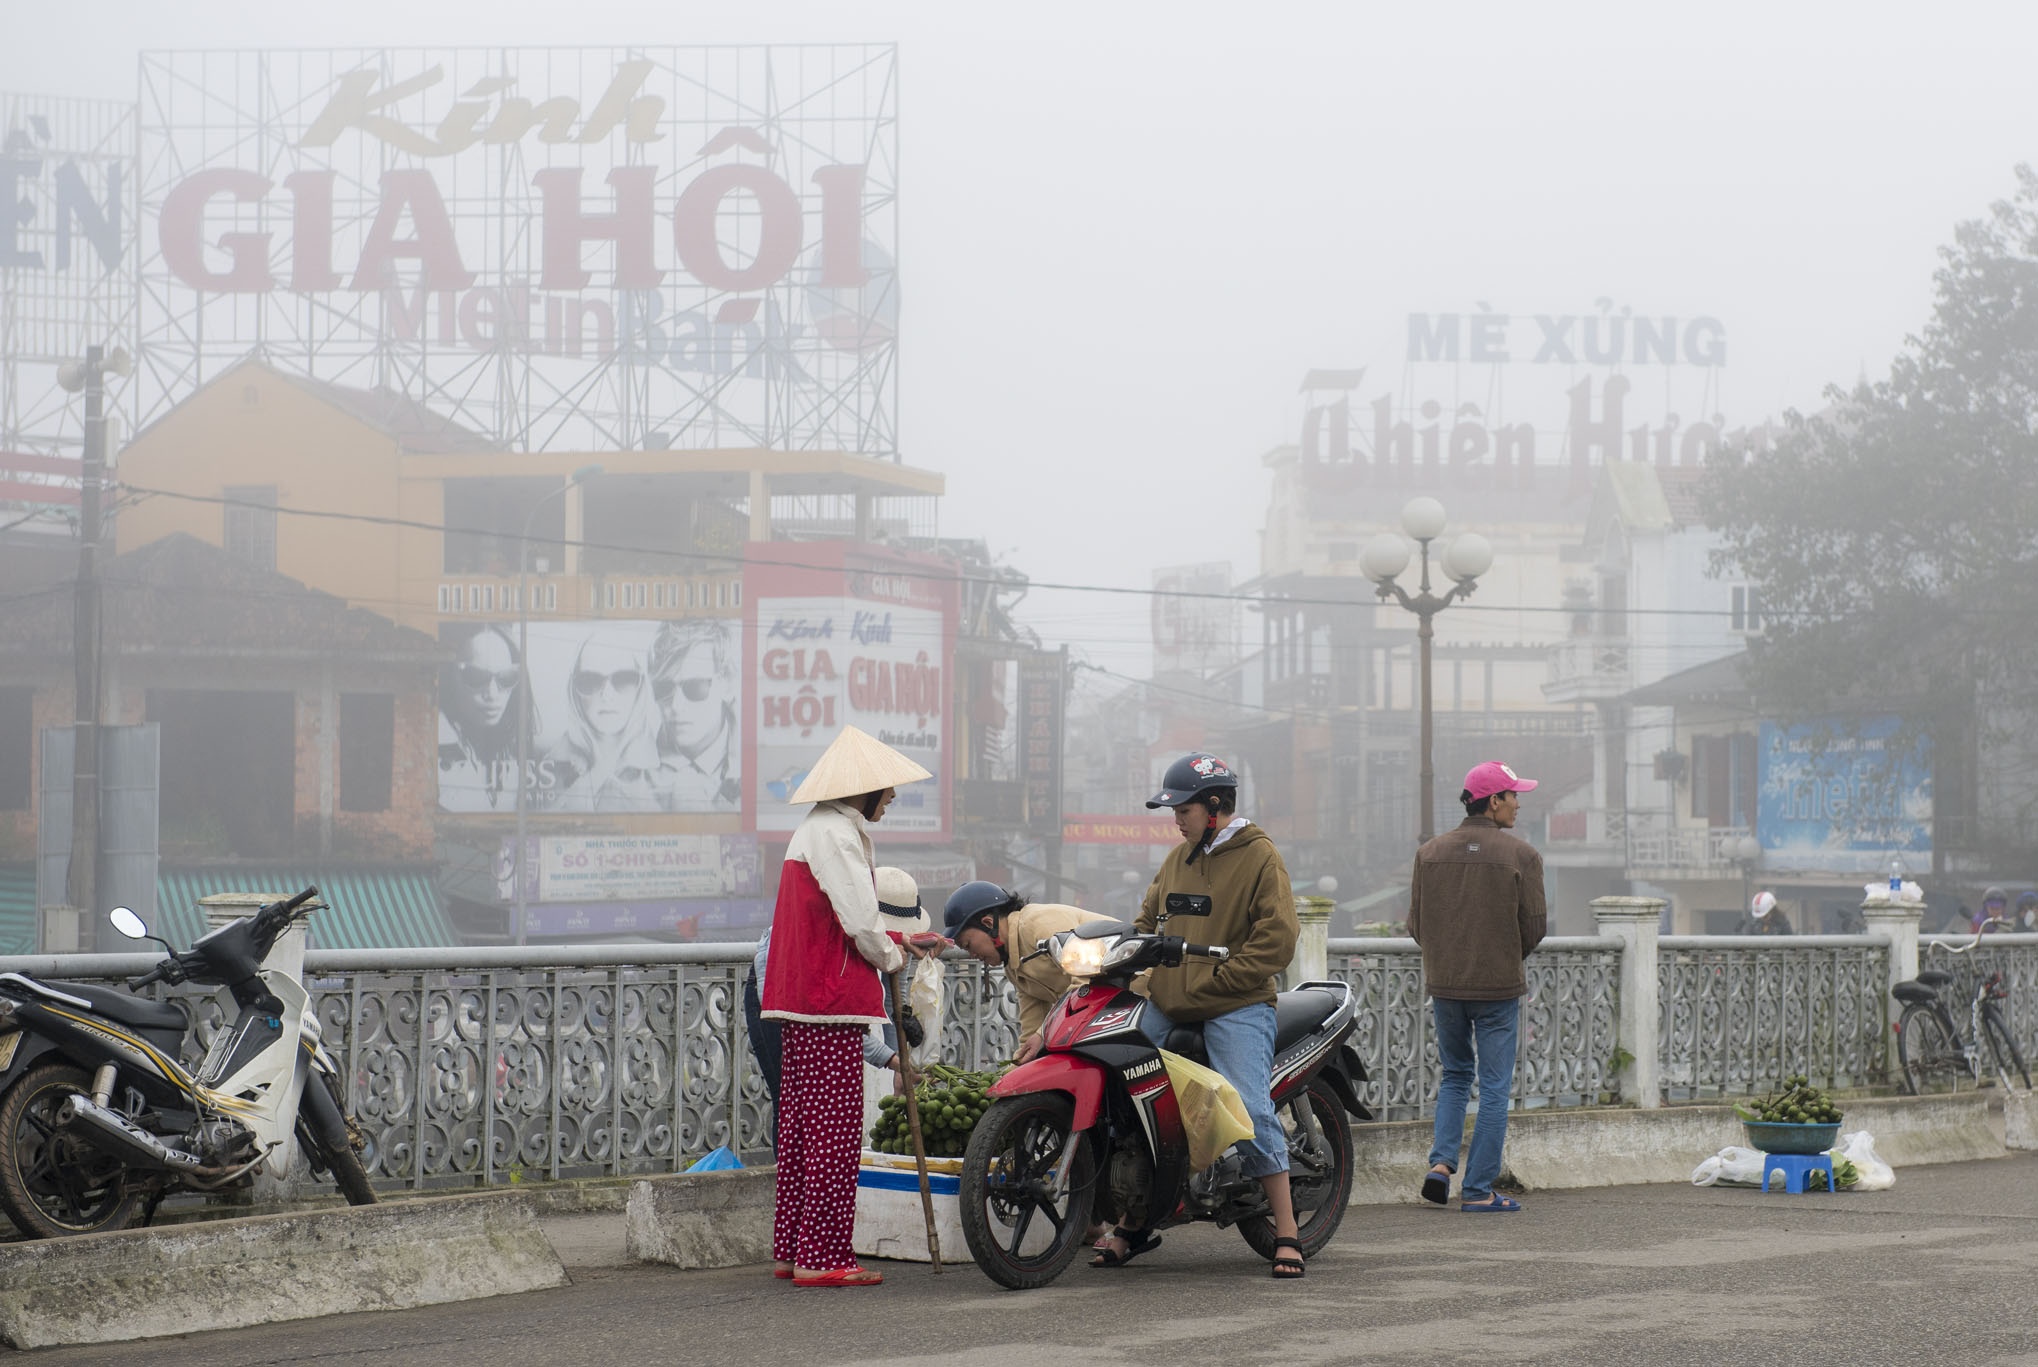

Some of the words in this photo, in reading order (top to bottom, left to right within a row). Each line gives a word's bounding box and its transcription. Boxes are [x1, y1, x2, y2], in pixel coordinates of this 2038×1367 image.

[300, 58, 669, 158] Kính
[158, 167, 478, 293] GIA
[532, 126, 873, 323] HỘI
[1407, 300, 1511, 363] MÈ
[1532, 296, 1728, 367] XỬNG
[1302, 392, 1536, 496] Thiên
[767, 618, 834, 641] Kính
[850, 610, 893, 645] Kính
[762, 648, 839, 682] GIA
[848, 656, 893, 714] GIA
[894, 651, 940, 730] HỘI
[762, 684, 836, 738] HỘI
[1122, 1058, 1162, 1080] YAMAHA
